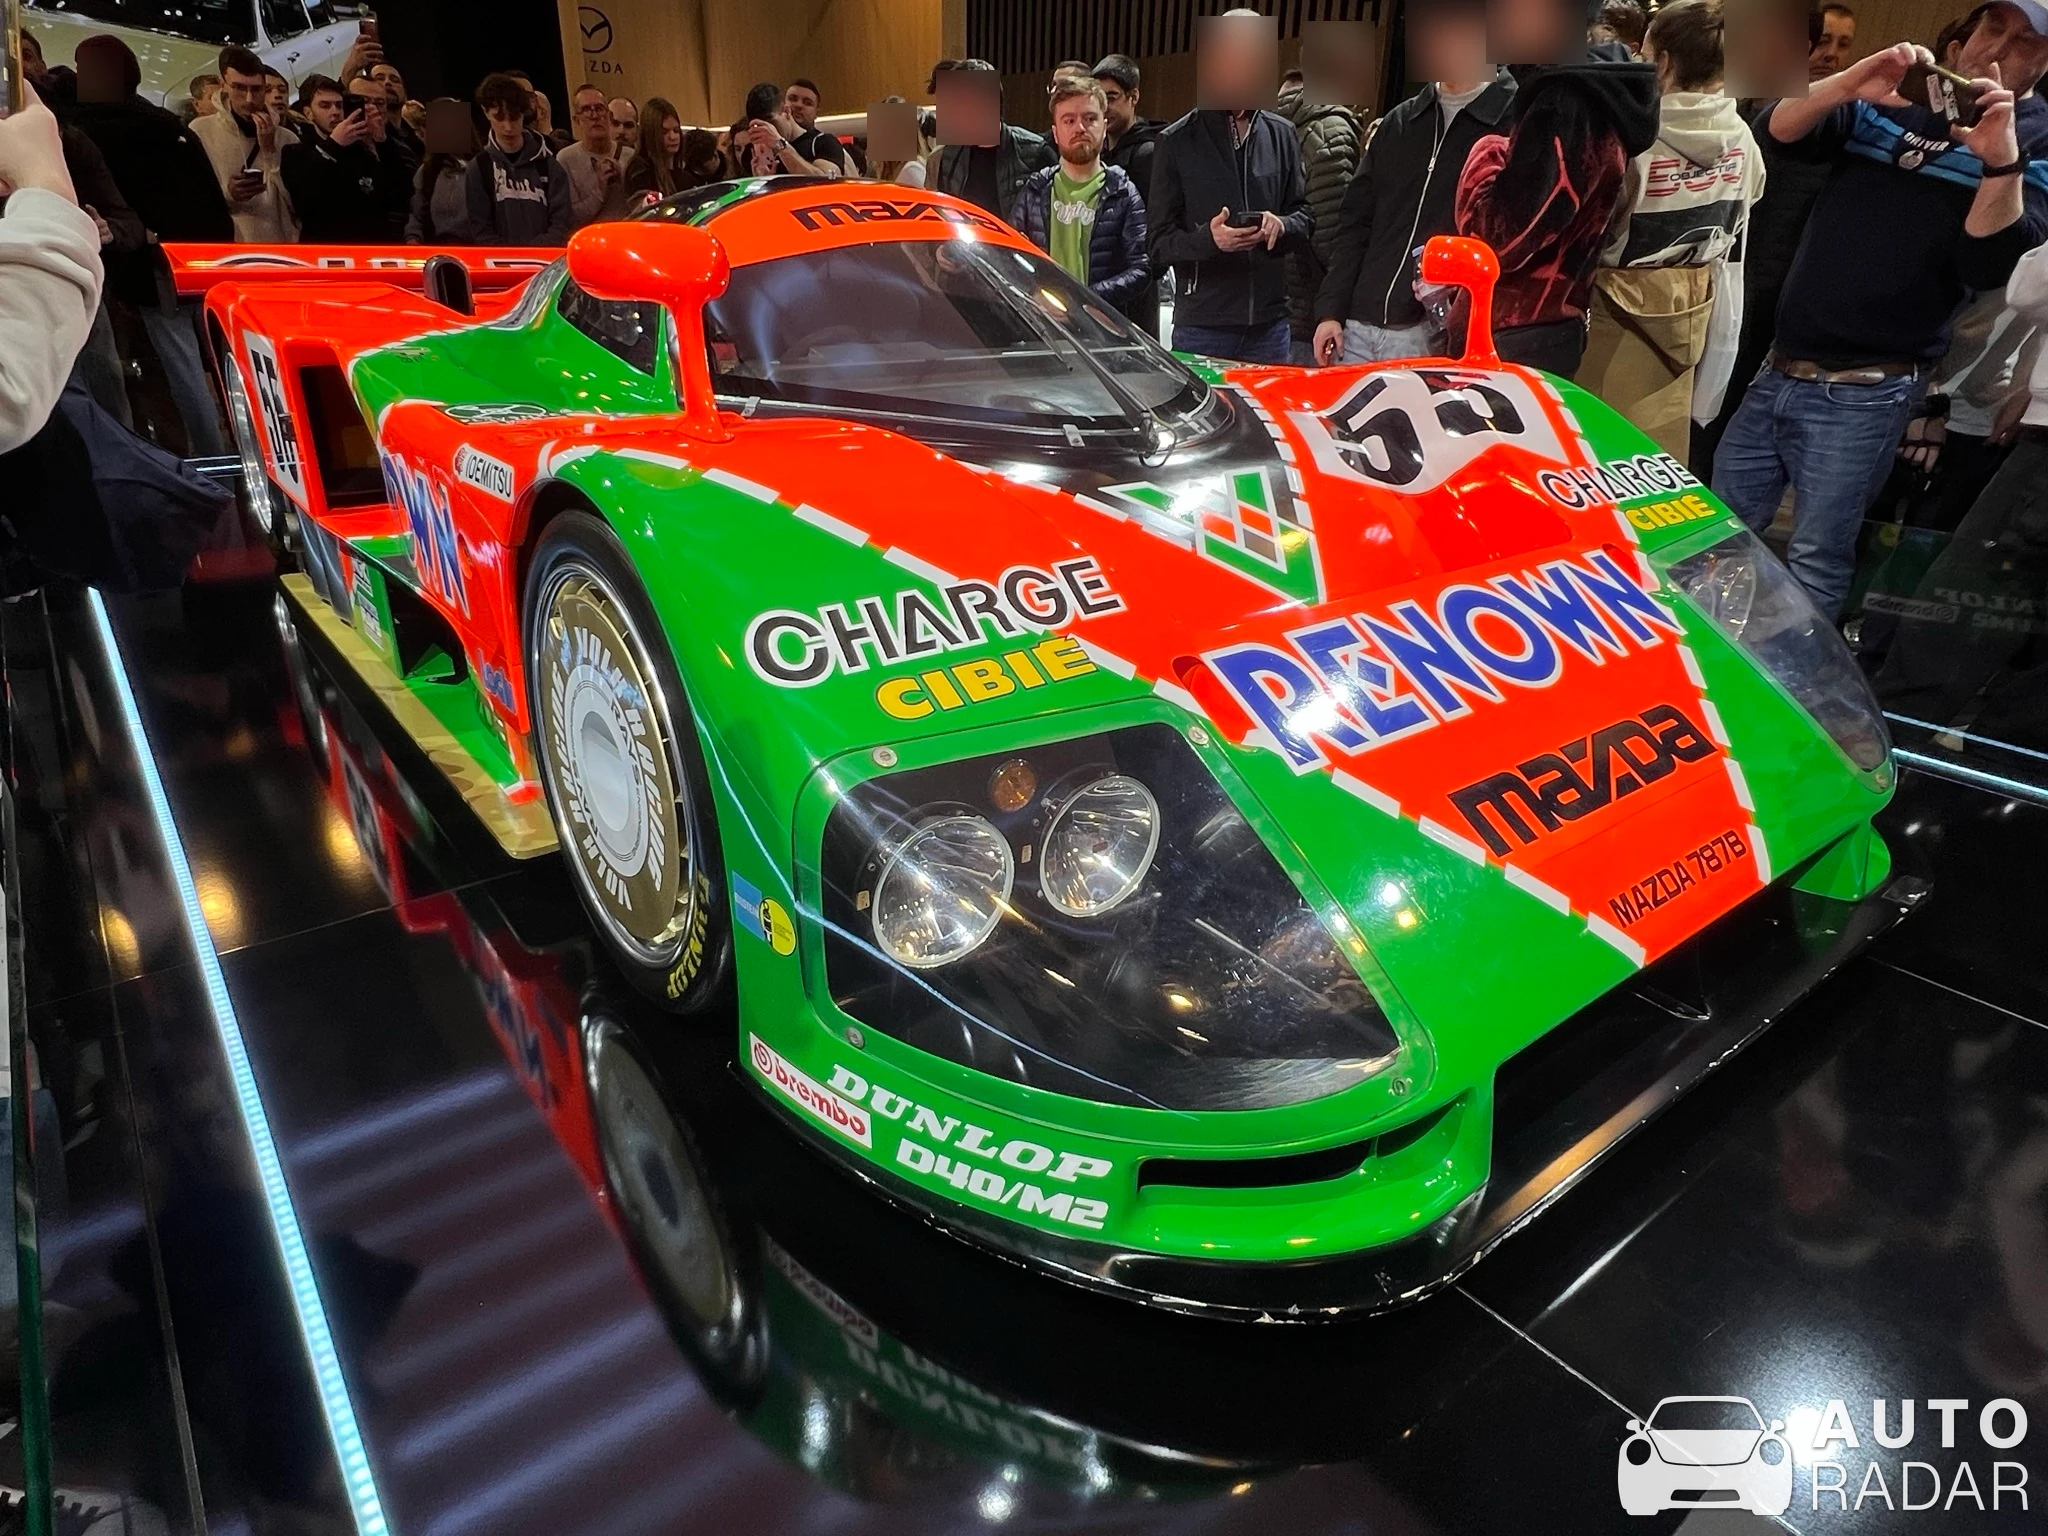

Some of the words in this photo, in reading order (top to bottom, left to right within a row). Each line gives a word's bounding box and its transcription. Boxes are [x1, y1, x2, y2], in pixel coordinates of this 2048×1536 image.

[590, 60, 623, 75] ZDA
[1669, 162, 1737, 181] OBJECTIF
[1903, 131, 1950, 151] DRIVER
[1327, 370, 1525, 486] 55
[465, 454, 514, 499] IDEMITSU
[1537, 452, 1703, 512] CHARGE
[744, 556, 1126, 689] CHARGE
[1199, 548, 1689, 776] RENOWN
[1608, 860, 1697, 929] MAZDA
[1685, 829, 1747, 880] 787B
[774, 1055, 866, 1136] brembo
[826, 1063, 1113, 1183] DUNLOP
[896, 1137, 1108, 1229] D40/M2
